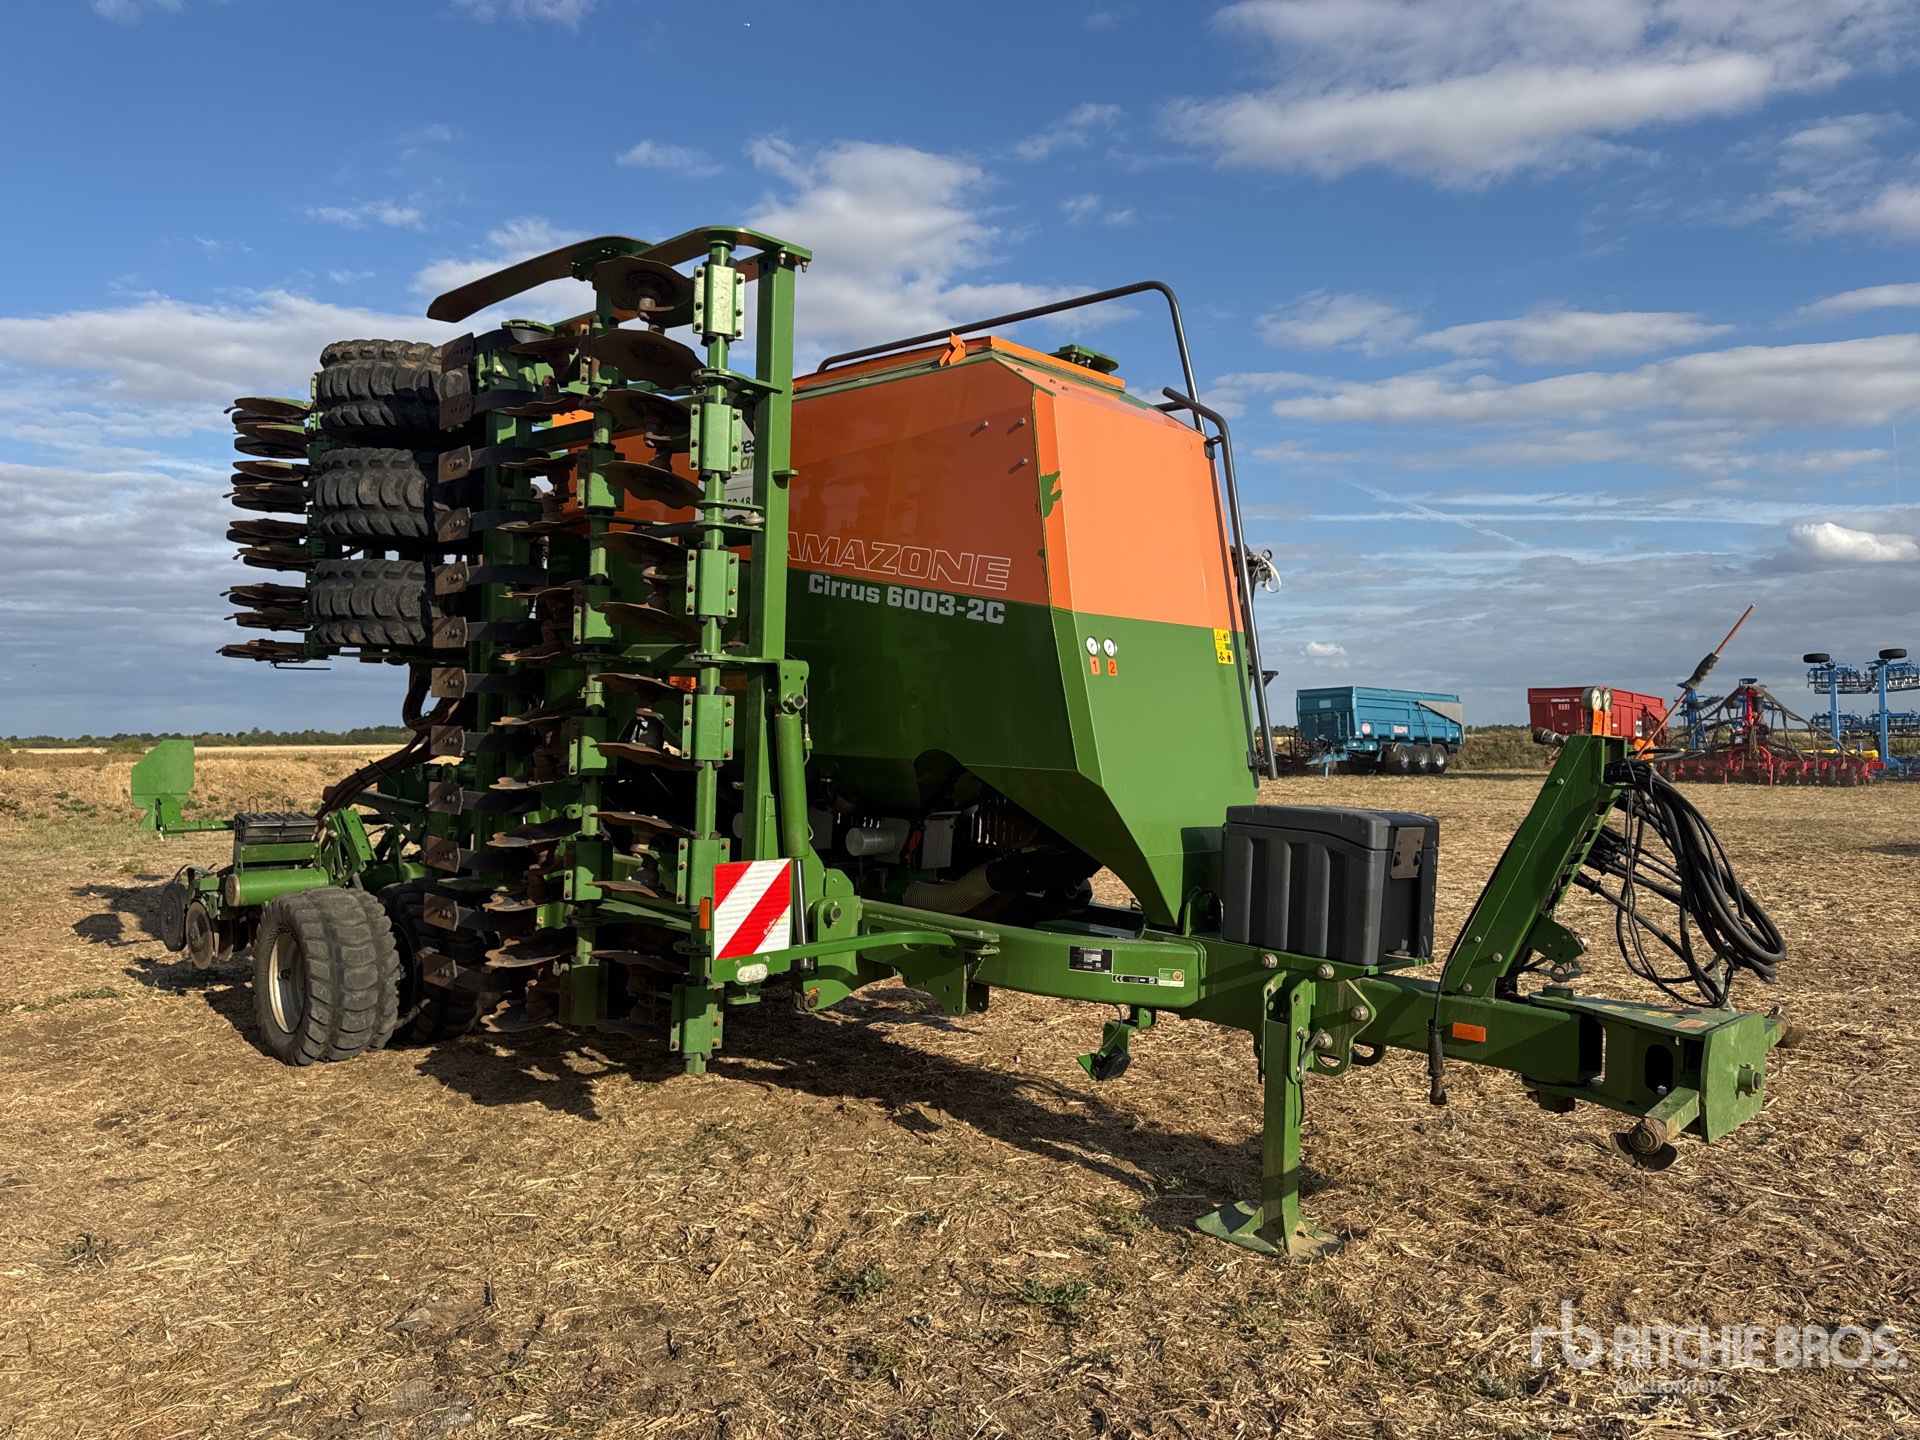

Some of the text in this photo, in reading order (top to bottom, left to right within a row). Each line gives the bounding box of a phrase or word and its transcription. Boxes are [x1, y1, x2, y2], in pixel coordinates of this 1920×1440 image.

[808, 573, 1005, 624] Cirrus 6003-2C
[1109, 661, 1116, 674] 2
